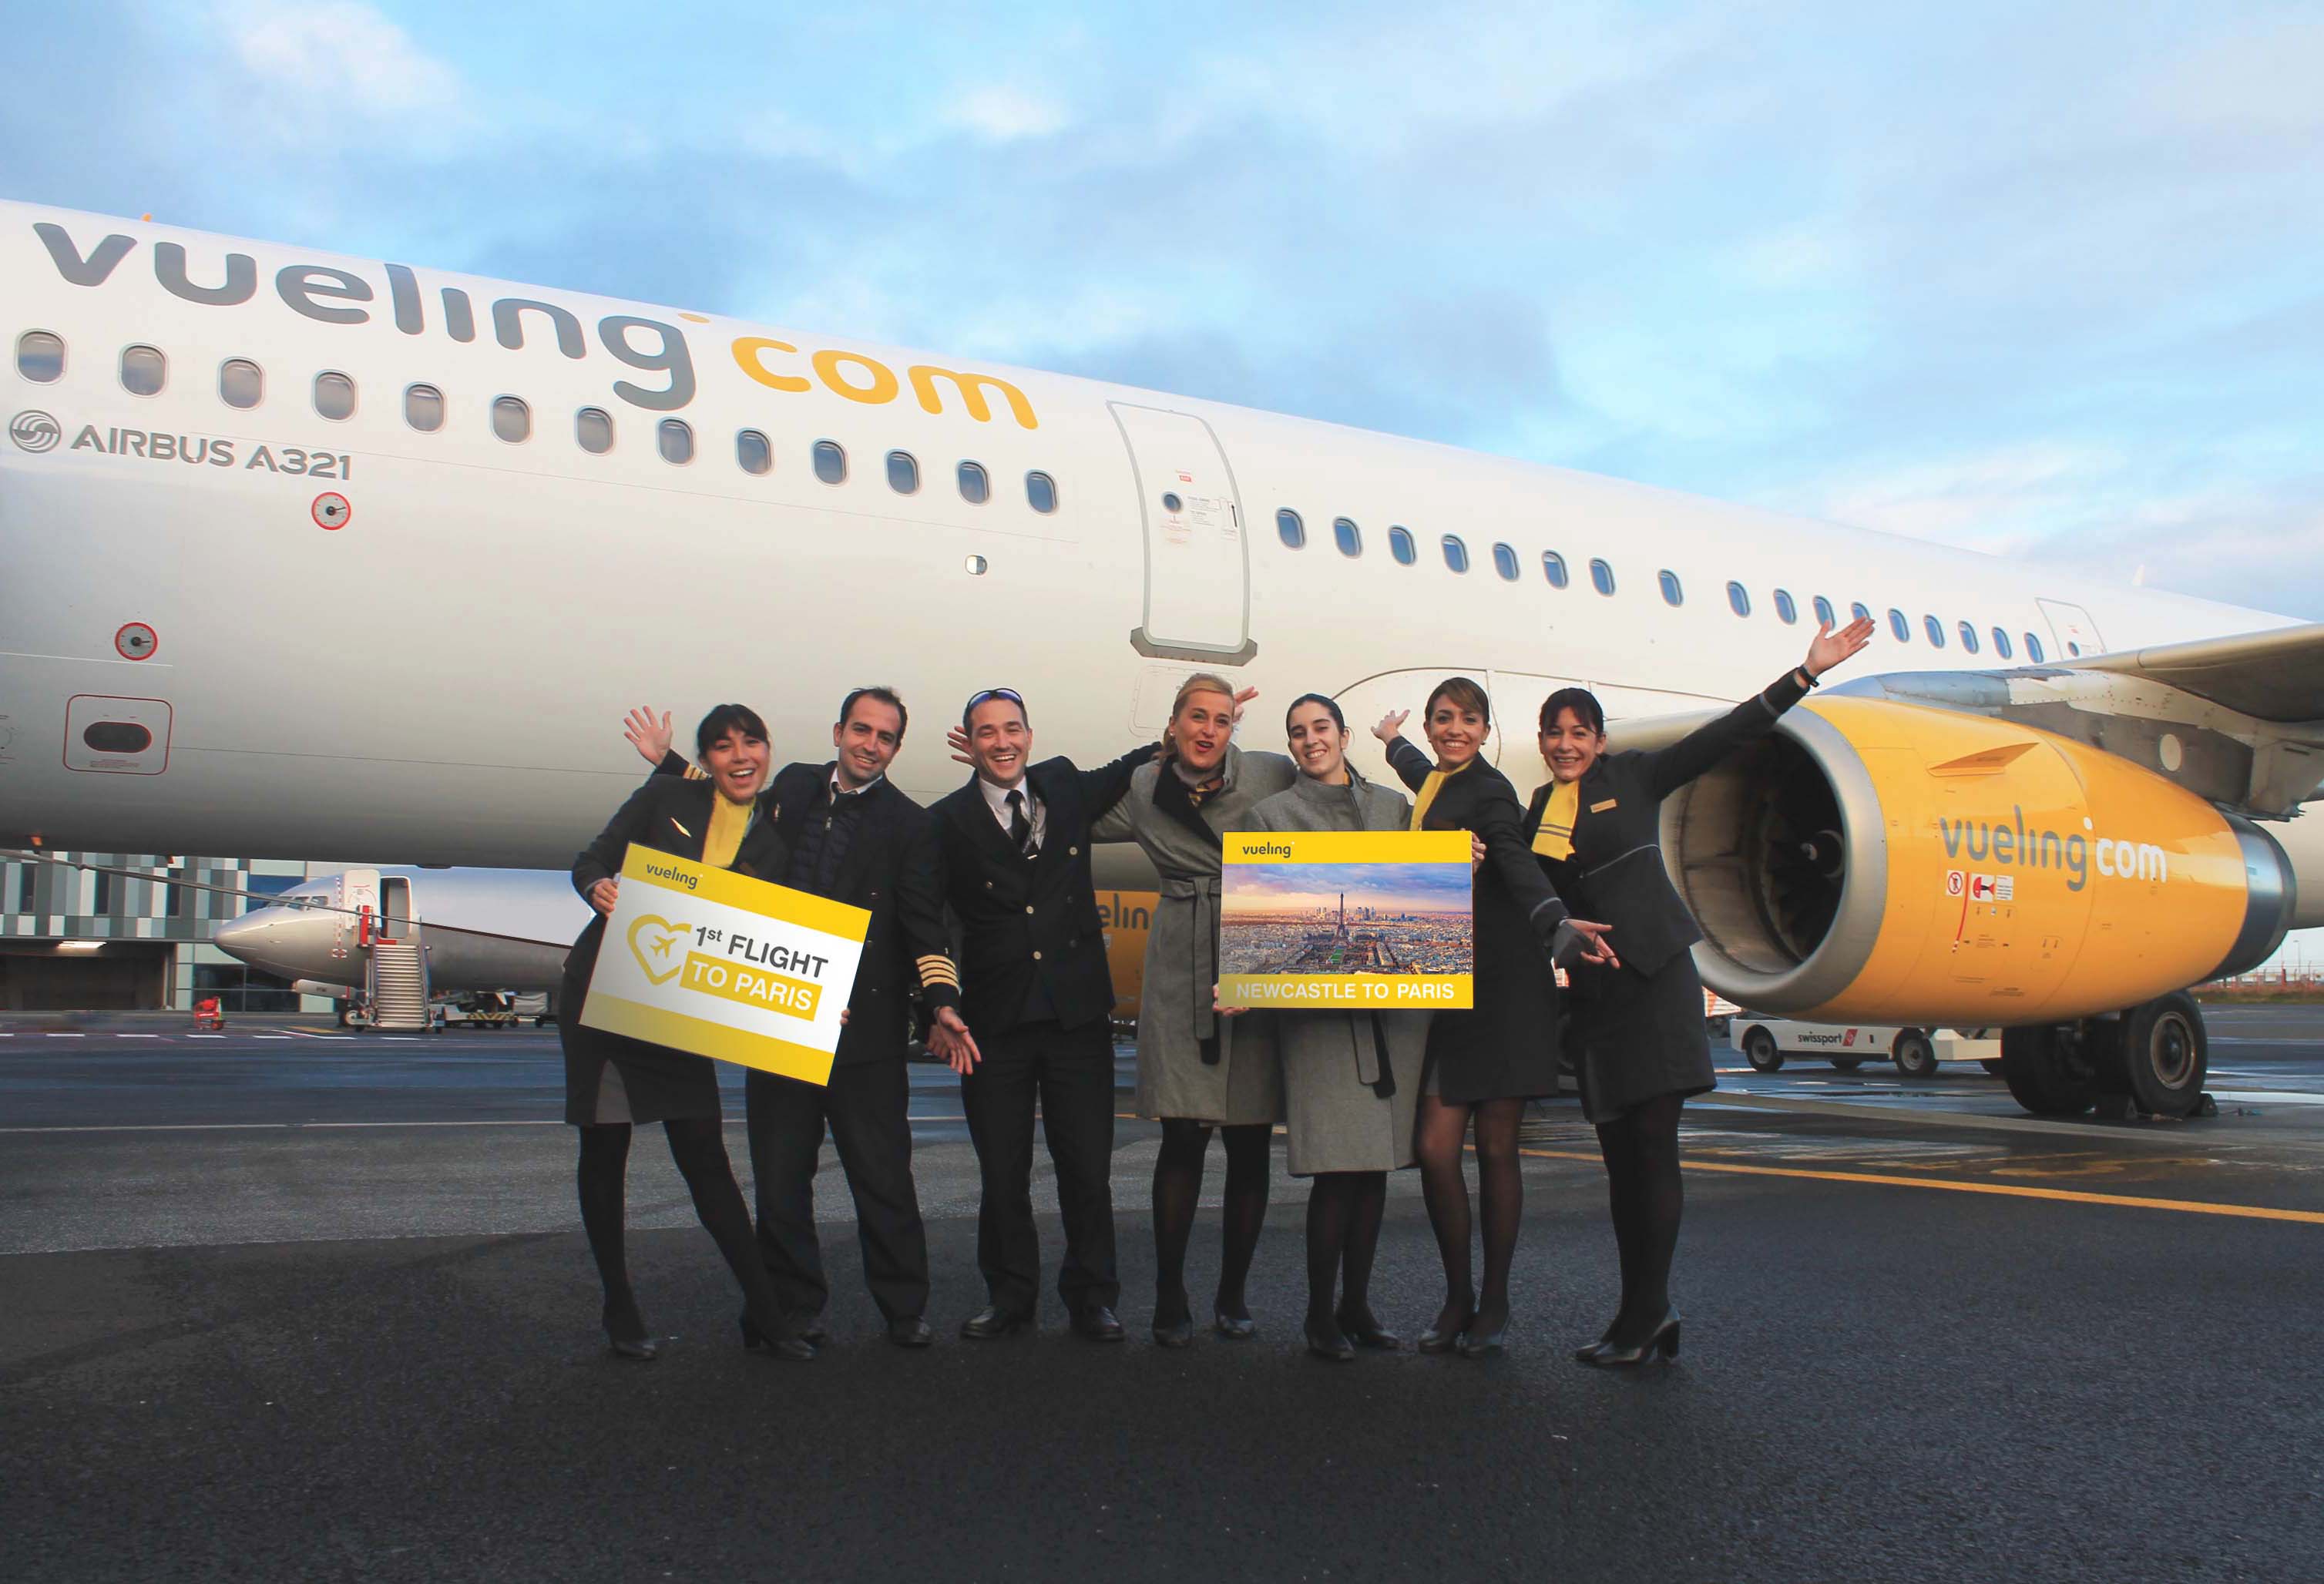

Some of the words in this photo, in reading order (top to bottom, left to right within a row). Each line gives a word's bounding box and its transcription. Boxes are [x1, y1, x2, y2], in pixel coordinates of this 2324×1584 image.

[71, 425, 233, 467] AIRBUS
[245, 445, 352, 480] A321
[1242, 841, 1291, 858] vueling
[646, 862, 698, 890] vueling
[728, 934, 829, 978] FLIGHT
[692, 960, 727, 988] TO
[734, 974, 814, 1011] PARIS
[1236, 983, 1357, 999] NEWCASTLE
[1362, 984, 1389, 999] TO
[1397, 983, 1455, 999] PARIS
[1798, 1030, 1842, 1046] swissport
